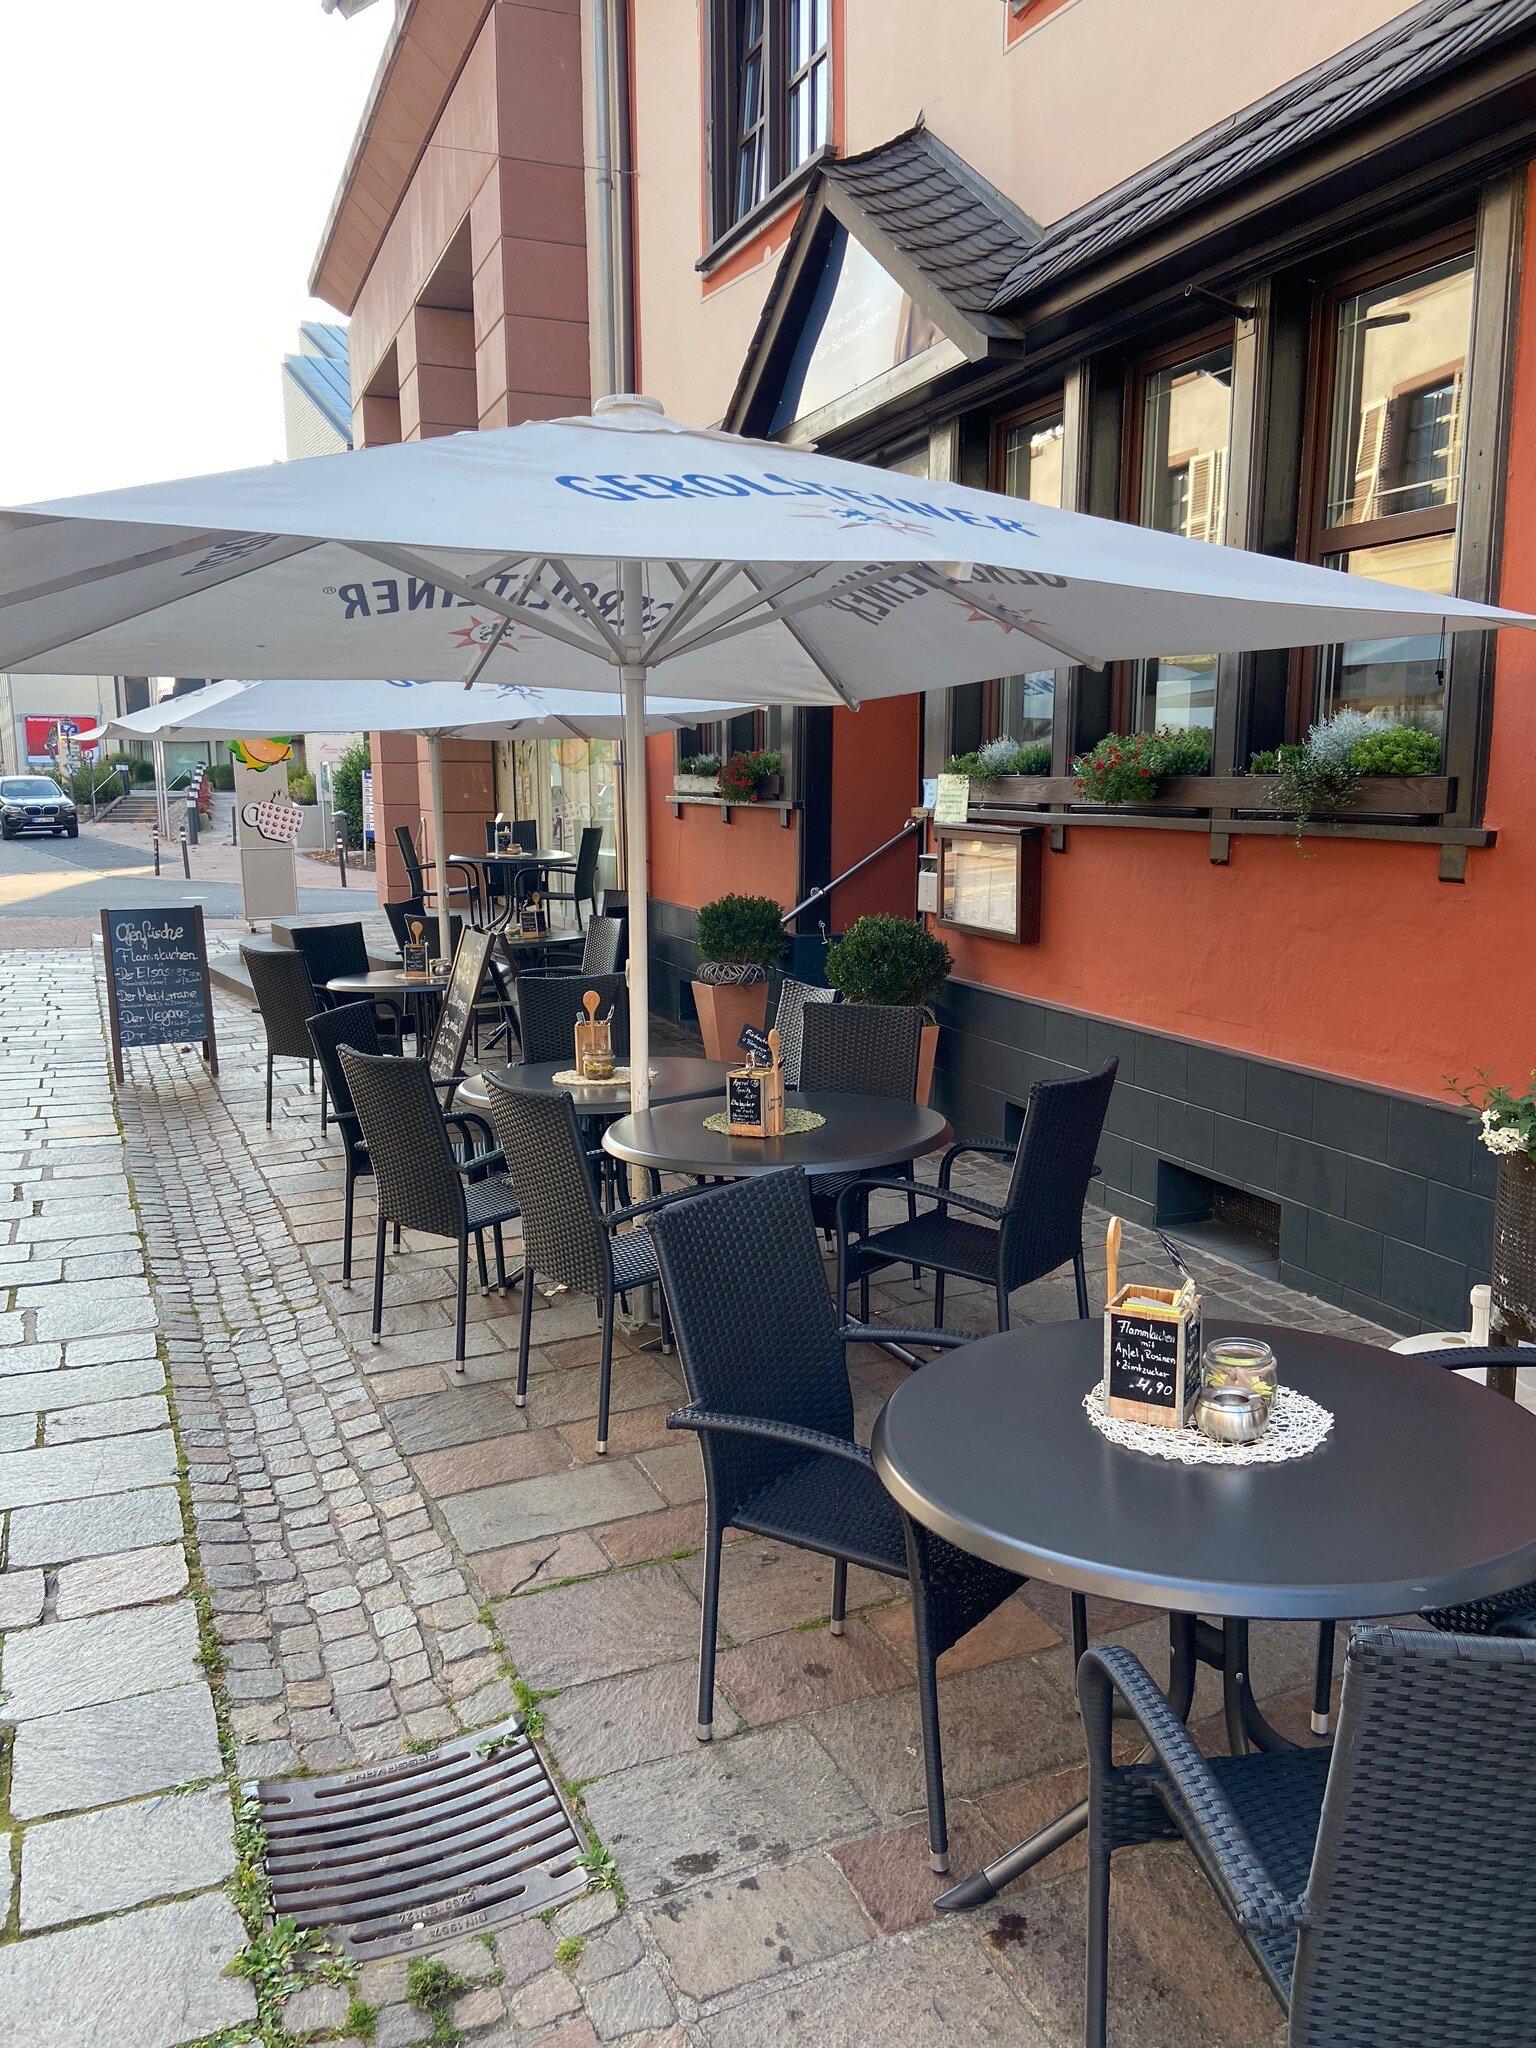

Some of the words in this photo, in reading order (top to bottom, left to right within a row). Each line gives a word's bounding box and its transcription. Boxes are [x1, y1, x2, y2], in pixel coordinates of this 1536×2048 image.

[554, 473, 1040, 538] GEROLSTEINER
[1117, 1320, 1175, 1343] Flammkuchen
[1140, 1339, 1155, 1349] mit
[1145, 1348, 1176, 1365] Rosinen
[1121, 1359, 1169, 1377] Zimtzucker
[344, 1751, 438, 1784] PASSAVANT
[465, 1912, 487, 1929] DIN
